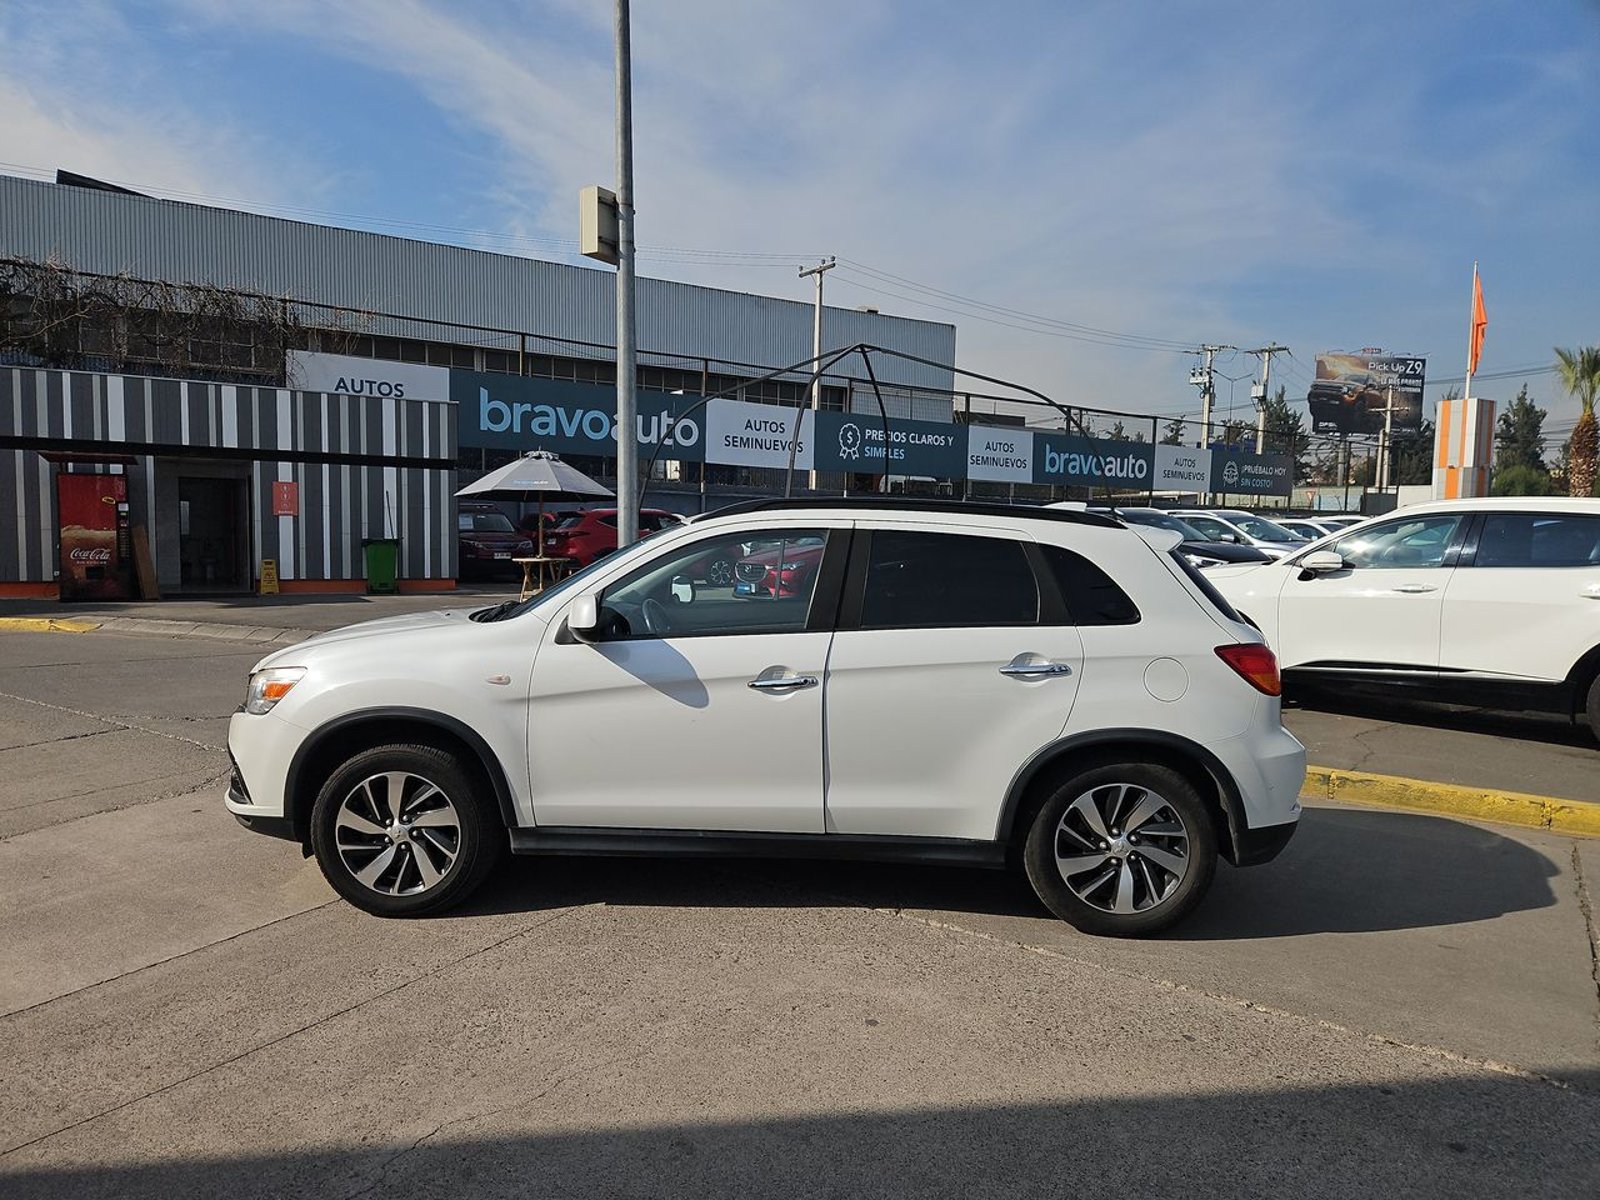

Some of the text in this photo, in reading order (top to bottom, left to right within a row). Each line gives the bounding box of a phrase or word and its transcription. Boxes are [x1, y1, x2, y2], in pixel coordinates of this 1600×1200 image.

[1368, 360, 1423, 374] Pick Up Z9
[334, 376, 405, 398] AUTOS
[744, 419, 786, 434] AUTOS
[909, 433, 946, 446] CLAROS
[947, 436, 954, 446] Y
[985, 441, 1015, 453] AUTOS
[970, 455, 1027, 469] SEMINUEVOS
[1045, 444, 1147, 479] bravoauto
[1174, 458, 1196, 468] AUTOS
[1163, 469, 1205, 481] SEMINUEVOS
[1274, 466, 1287, 476] HOY
